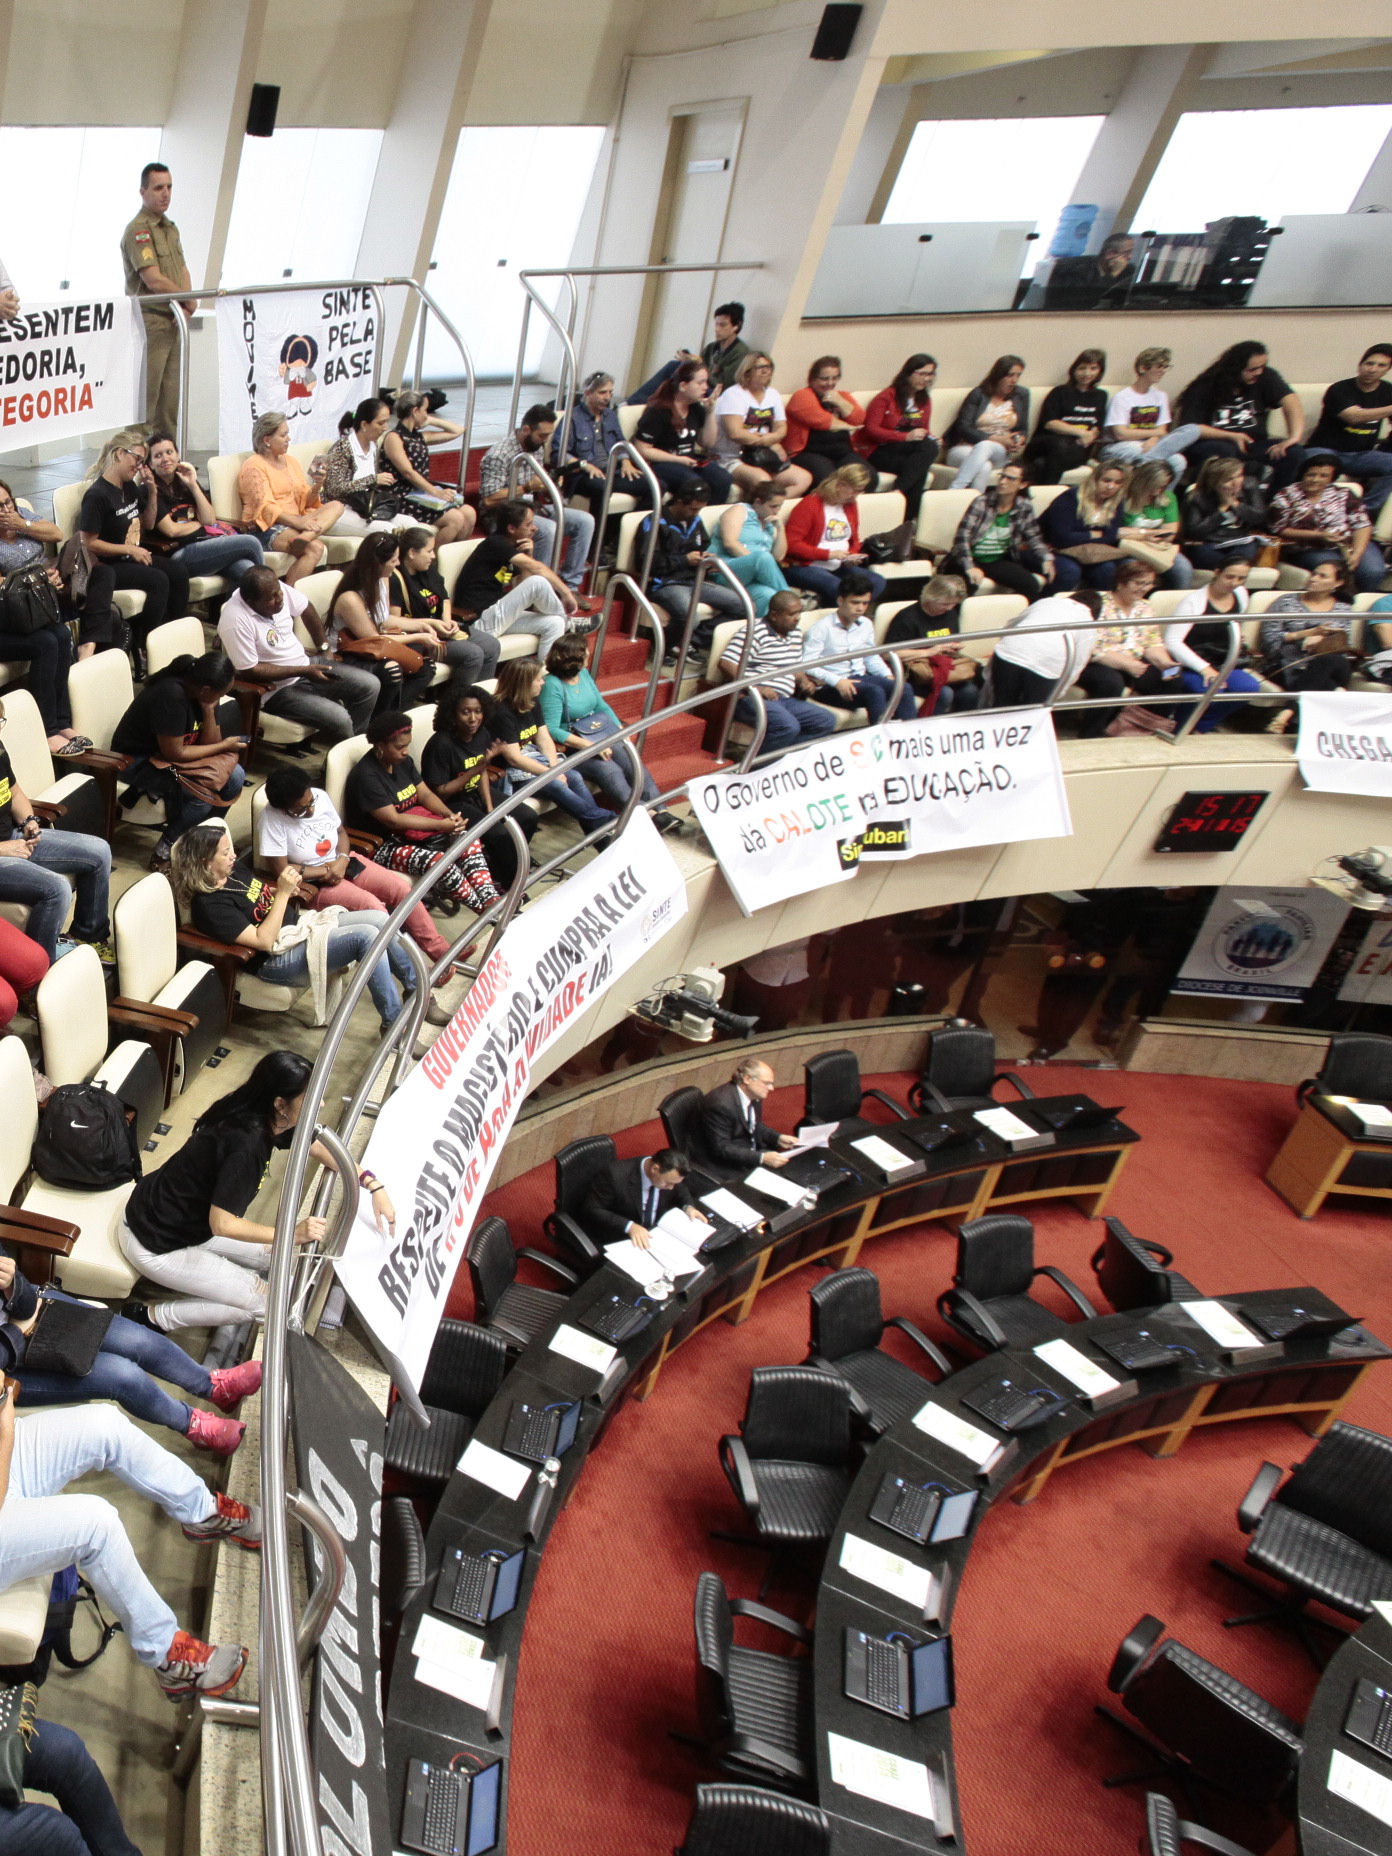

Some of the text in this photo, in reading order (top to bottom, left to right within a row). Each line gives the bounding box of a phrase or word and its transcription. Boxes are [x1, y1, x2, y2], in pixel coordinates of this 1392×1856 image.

[321, 286, 372, 319] SINTE
[328, 317, 375, 352] PELA
[242, 298, 258, 421] MOVIME
[324, 349, 373, 386] BASE
[703, 784, 719, 814] O
[813, 751, 845, 783] de
[888, 729, 934, 761] mais
[940, 728, 986, 755] uma
[992, 724, 1033, 749] vez
[738, 820, 768, 854] dá
[763, 793, 853, 844] CALOTE
[593, 892, 625, 926] A
[607, 864, 648, 915] LEI
